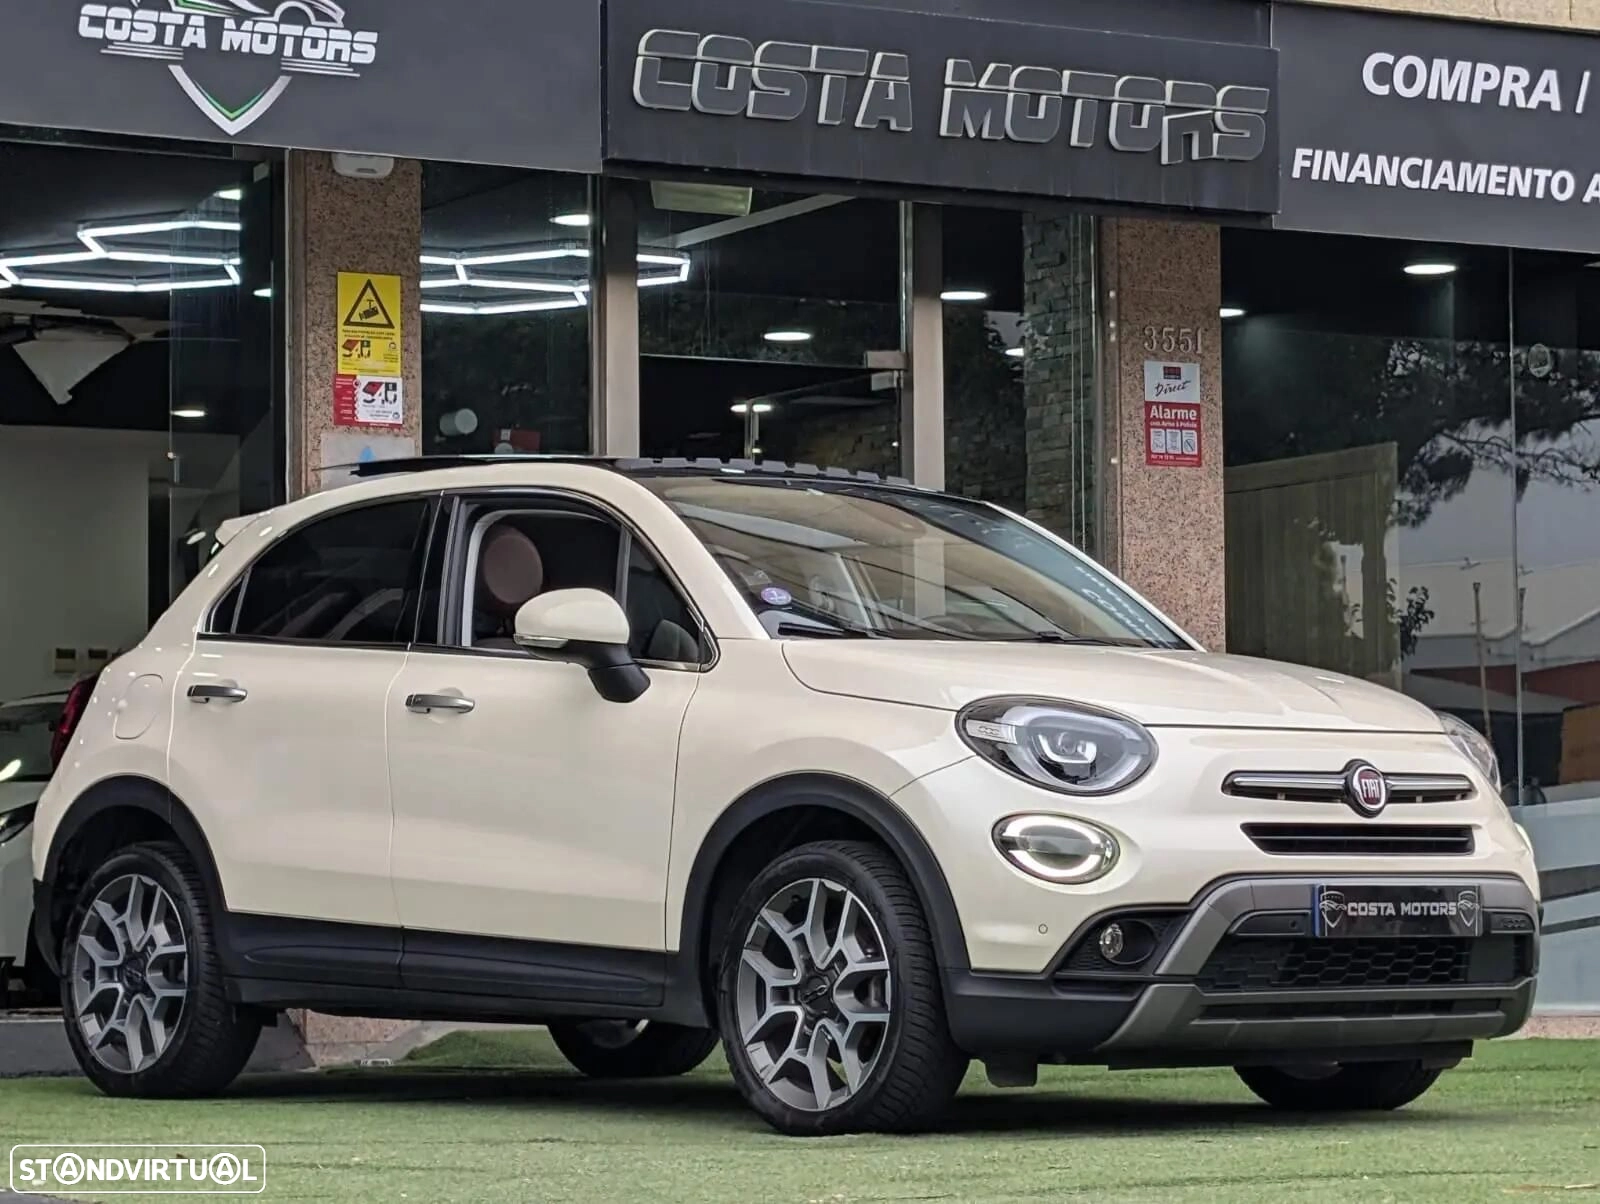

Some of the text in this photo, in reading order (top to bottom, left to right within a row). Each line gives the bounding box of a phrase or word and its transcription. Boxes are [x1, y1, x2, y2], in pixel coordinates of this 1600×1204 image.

[78, 3, 378, 64] COSTA MOTORS
[632, 28, 1271, 165] COSTA MOTORS
[1362, 52, 1562, 112] COMPRA
[1291, 147, 1576, 202] FINANCIAMENTO
[1144, 326, 1203, 354] 3551
[1149, 404, 1198, 420] Alarme
[1361, 778, 1380, 799] FIAT
[1347, 901, 1457, 917] COSTA MOTORS
